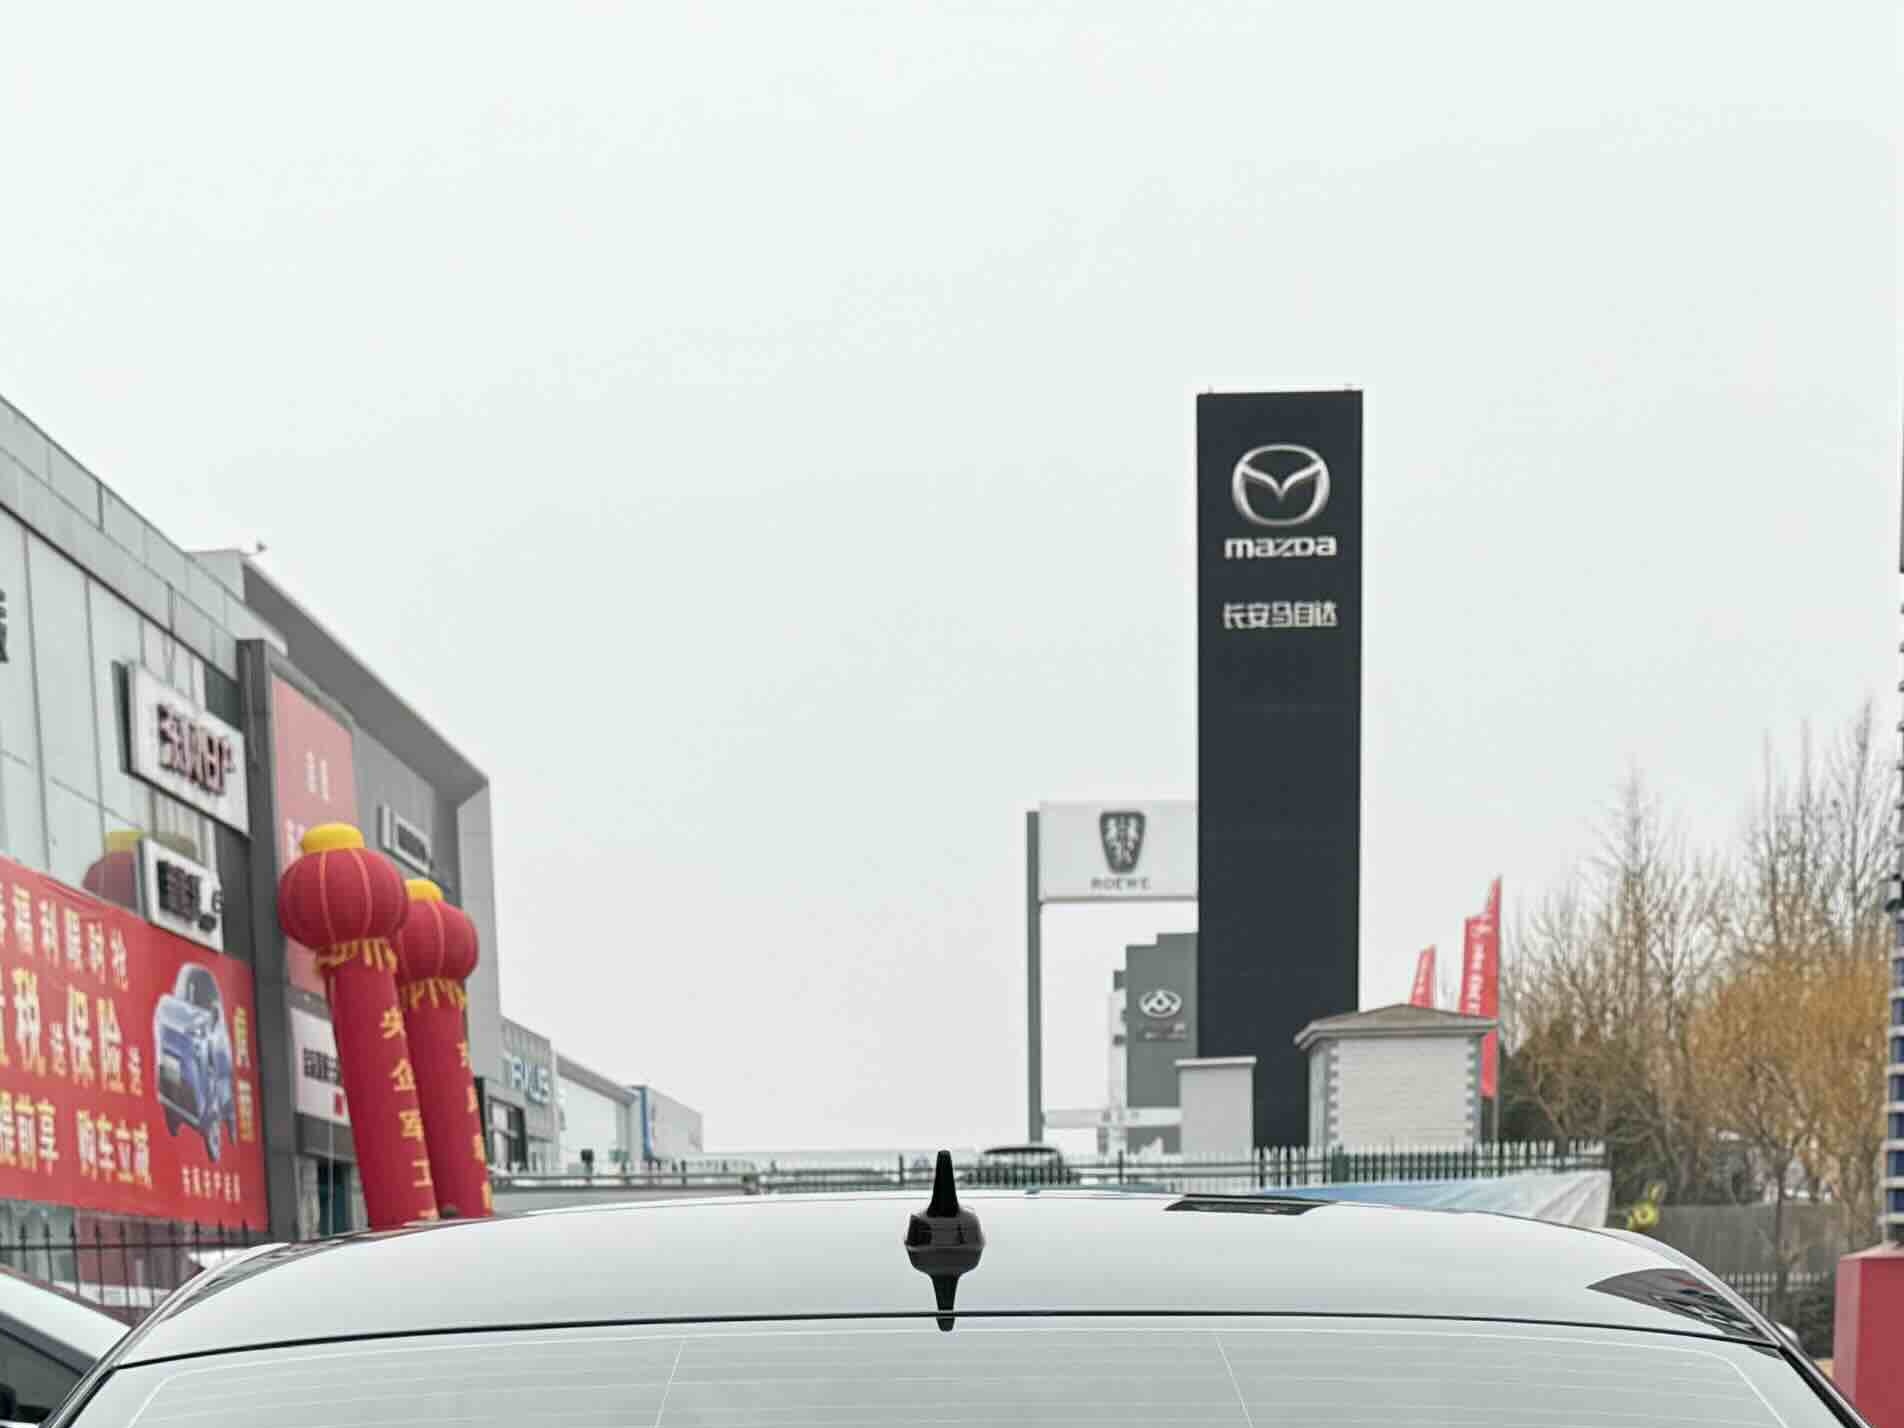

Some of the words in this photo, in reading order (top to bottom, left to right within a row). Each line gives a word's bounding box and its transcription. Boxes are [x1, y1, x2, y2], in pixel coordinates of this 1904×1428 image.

[1224, 535, 1337, 559] mazda
[1223, 600, 1338, 630] 长安马自达
